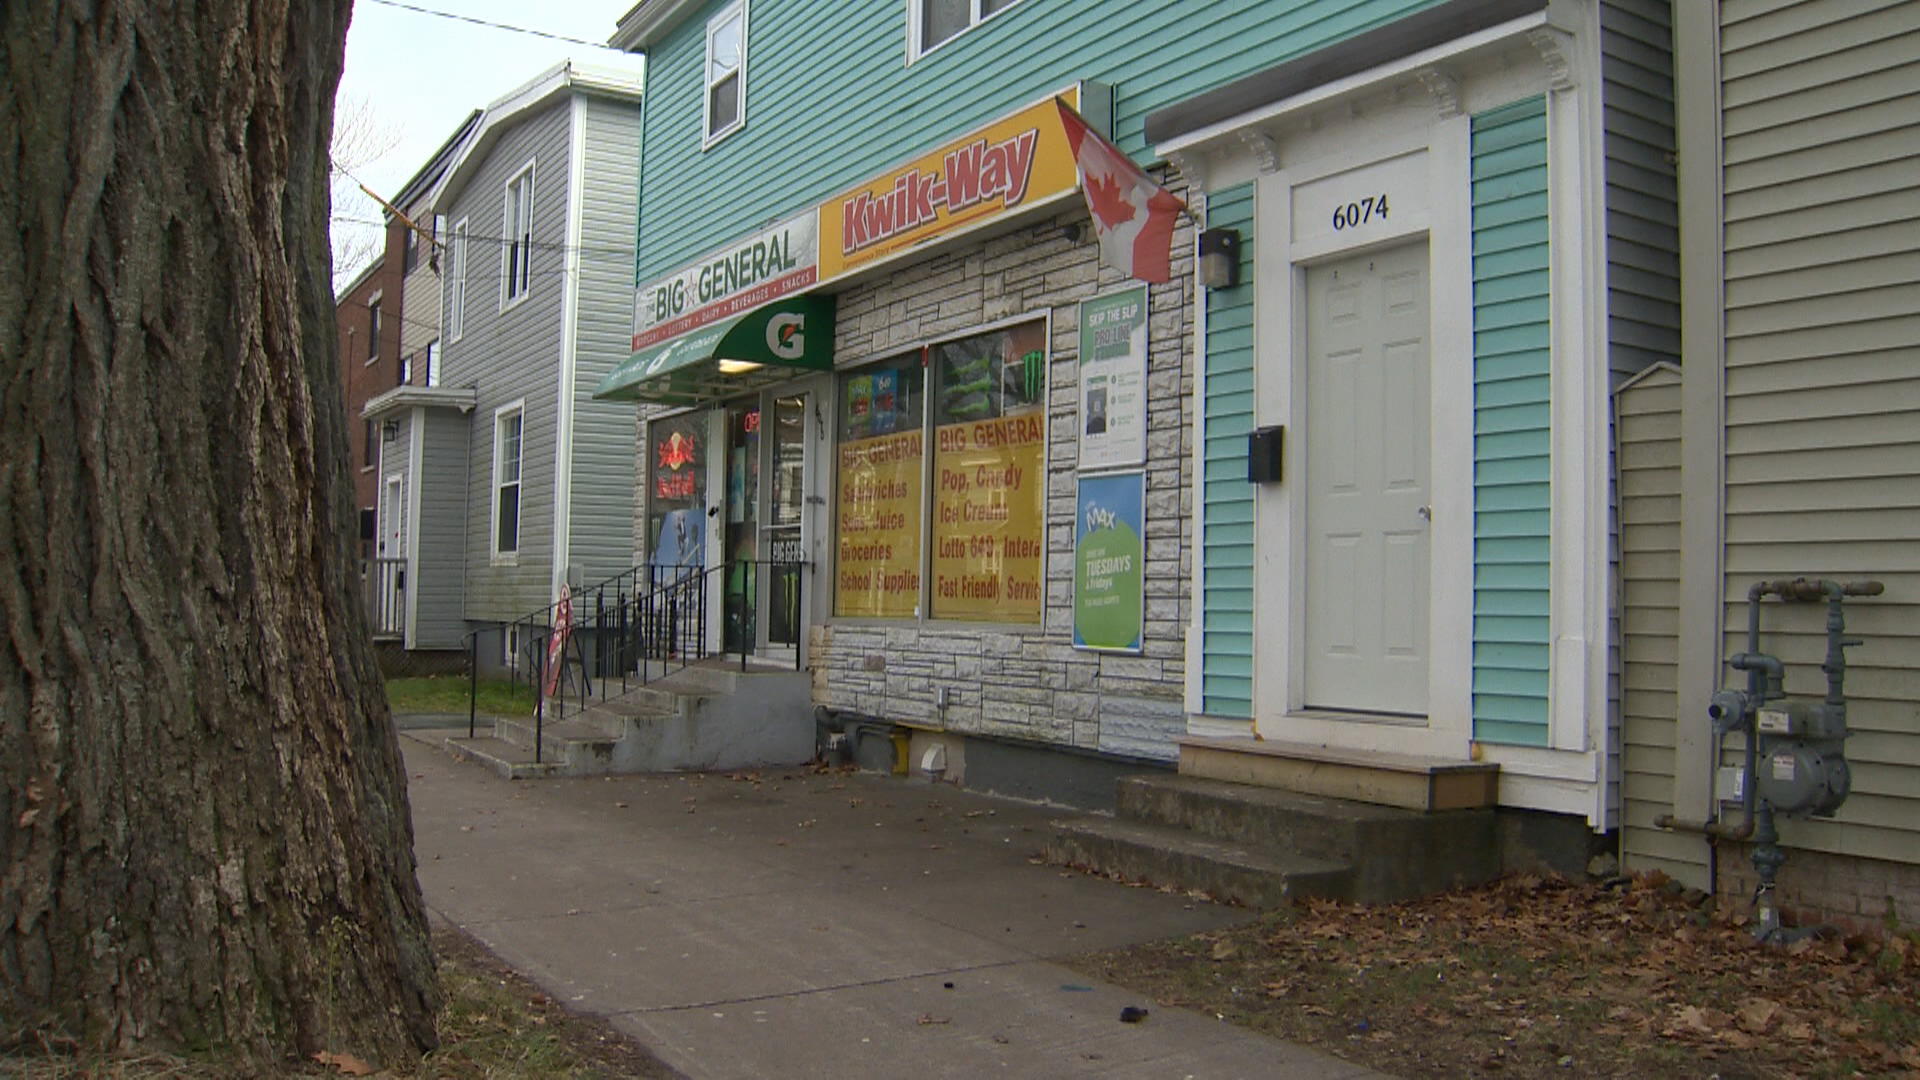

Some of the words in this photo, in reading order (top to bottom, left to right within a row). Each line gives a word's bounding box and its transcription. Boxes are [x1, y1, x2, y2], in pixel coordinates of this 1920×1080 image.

[842, 128, 1040, 256] Kwik-Way
[1333, 193, 1389, 230] 6074
[656, 279, 684, 321] BIG
[698, 229, 797, 303] GENERAL
[702, 307, 720, 323] DAIRY
[731, 288, 769, 312] BEVERAGES
[782, 271, 810, 292] SNACKS
[1088, 311, 1105, 328] SKIP
[1107, 308, 1120, 323] THE
[1122, 303, 1138, 320] SLIP
[766, 312, 805, 359] G
[941, 427, 966, 452] BIG
[842, 446, 862, 468] BIG
[942, 468, 970, 493] Pop,
[873, 509, 905, 531] Juice
[940, 501, 959, 524] Ice
[841, 539, 892, 562] Groceries
[939, 536, 965, 559] Lotto
[1086, 554, 1131, 577] TUESDAYS
[840, 567, 872, 592] School
[938, 574, 958, 599] Fast
[962, 574, 1000, 604] Friendly
